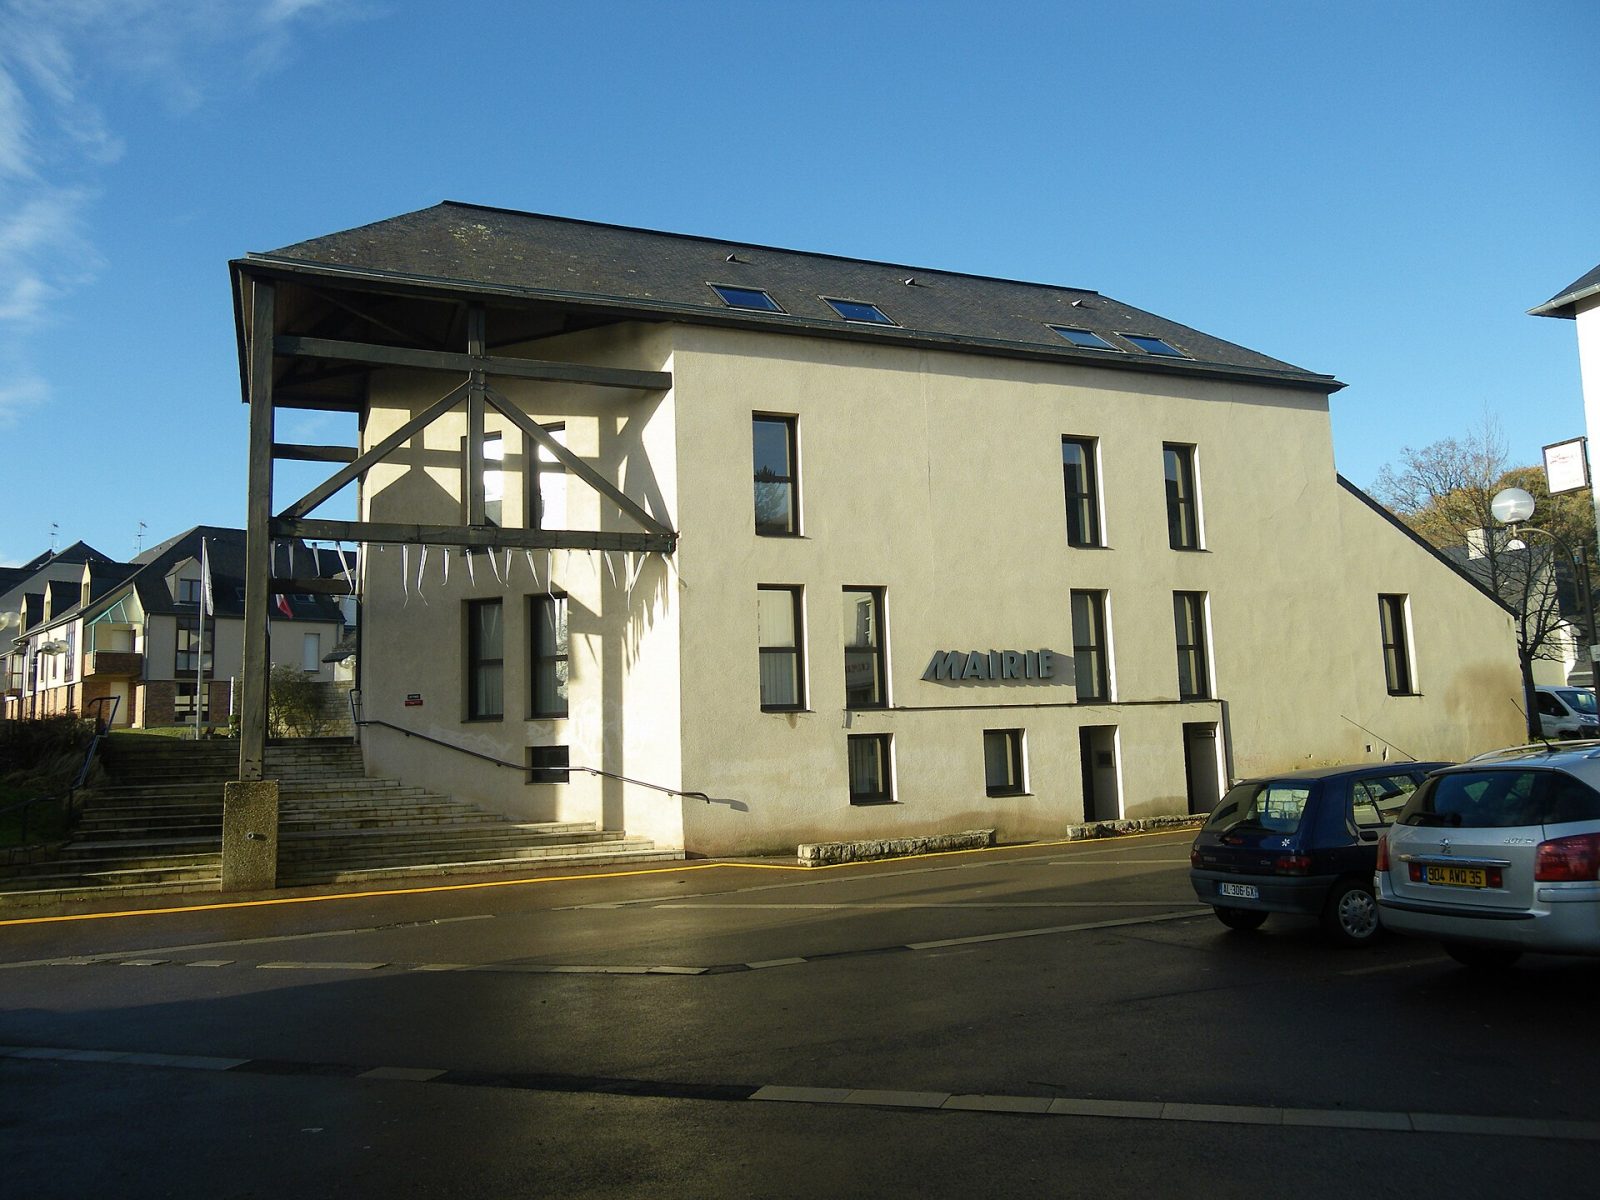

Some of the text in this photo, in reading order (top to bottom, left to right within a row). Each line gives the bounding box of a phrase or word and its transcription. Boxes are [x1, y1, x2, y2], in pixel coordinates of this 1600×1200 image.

[921, 648, 1053, 680] MAIRIE
[1428, 867, 1445, 881] 904
[1469, 871, 1482, 884] 35
